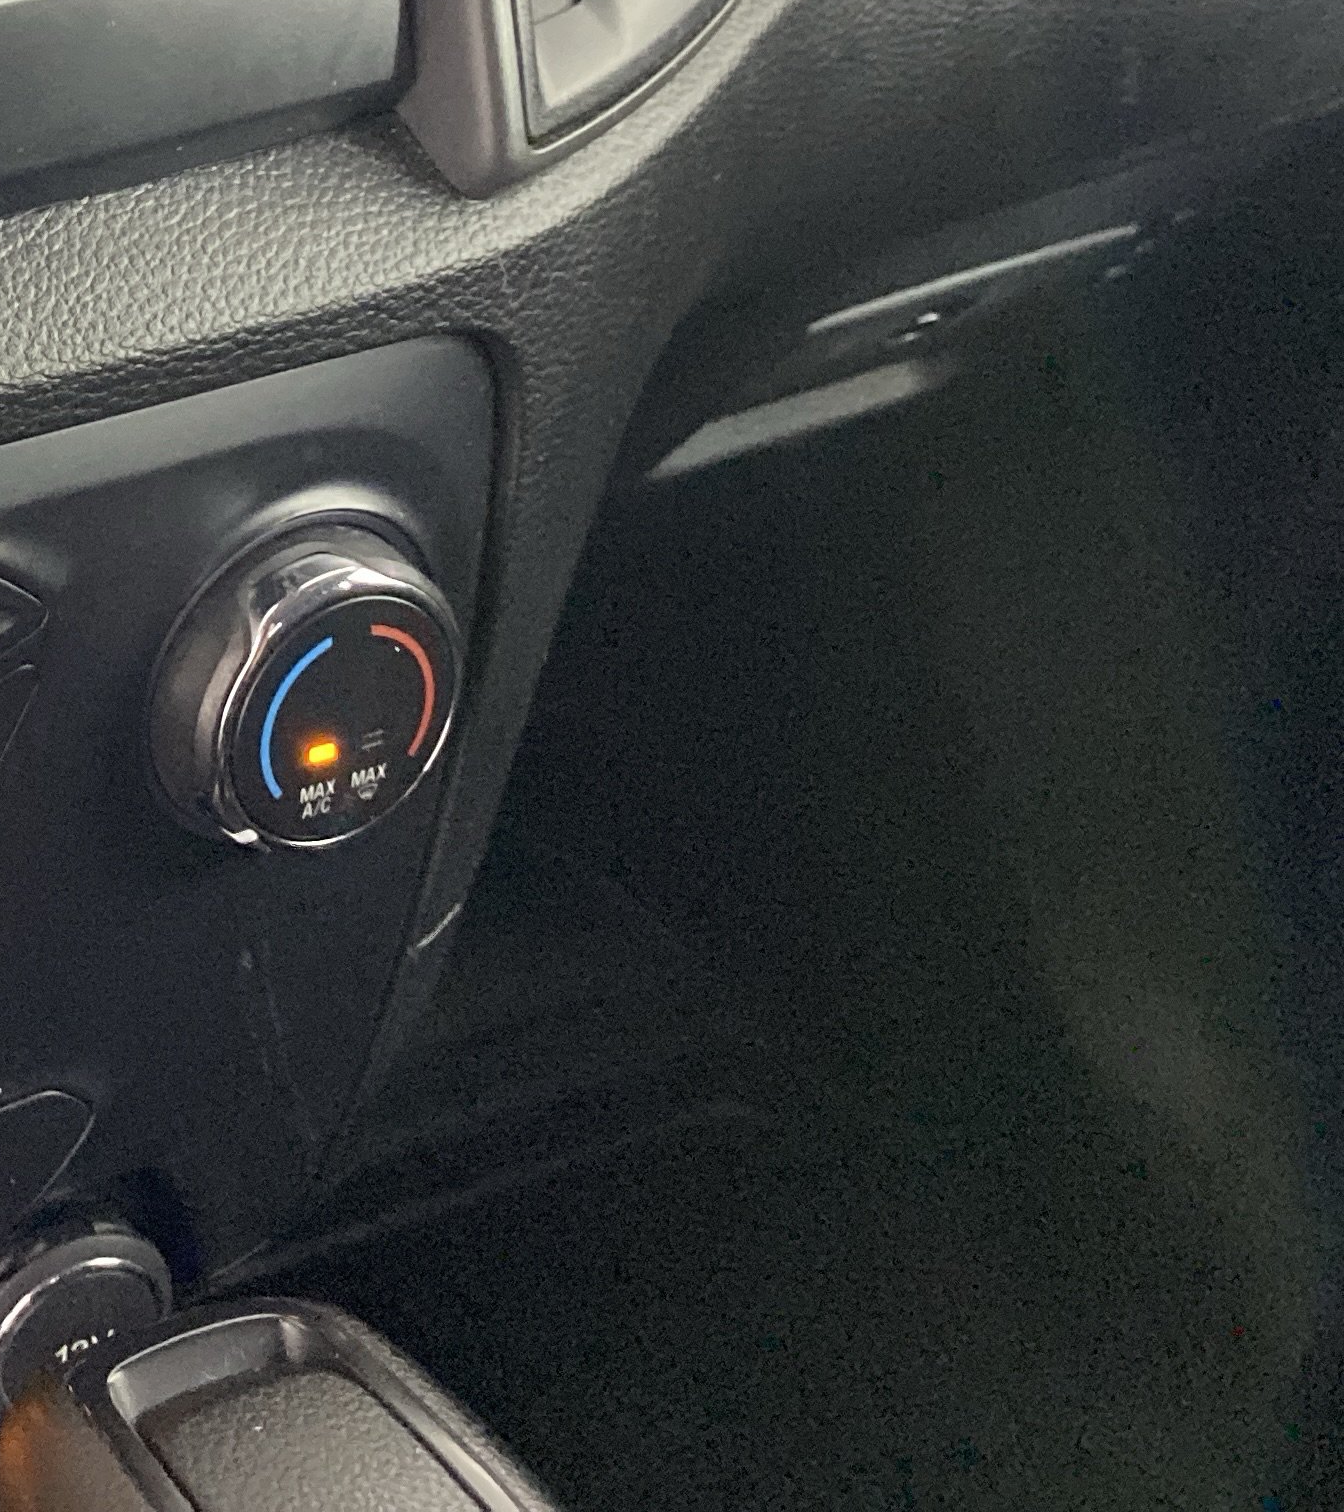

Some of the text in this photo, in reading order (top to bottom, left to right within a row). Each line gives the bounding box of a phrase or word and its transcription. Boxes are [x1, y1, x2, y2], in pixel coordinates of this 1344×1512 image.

[349, 762, 388, 788] MAX
[298, 777, 337, 805] MAX
[300, 796, 332, 820] A/C
